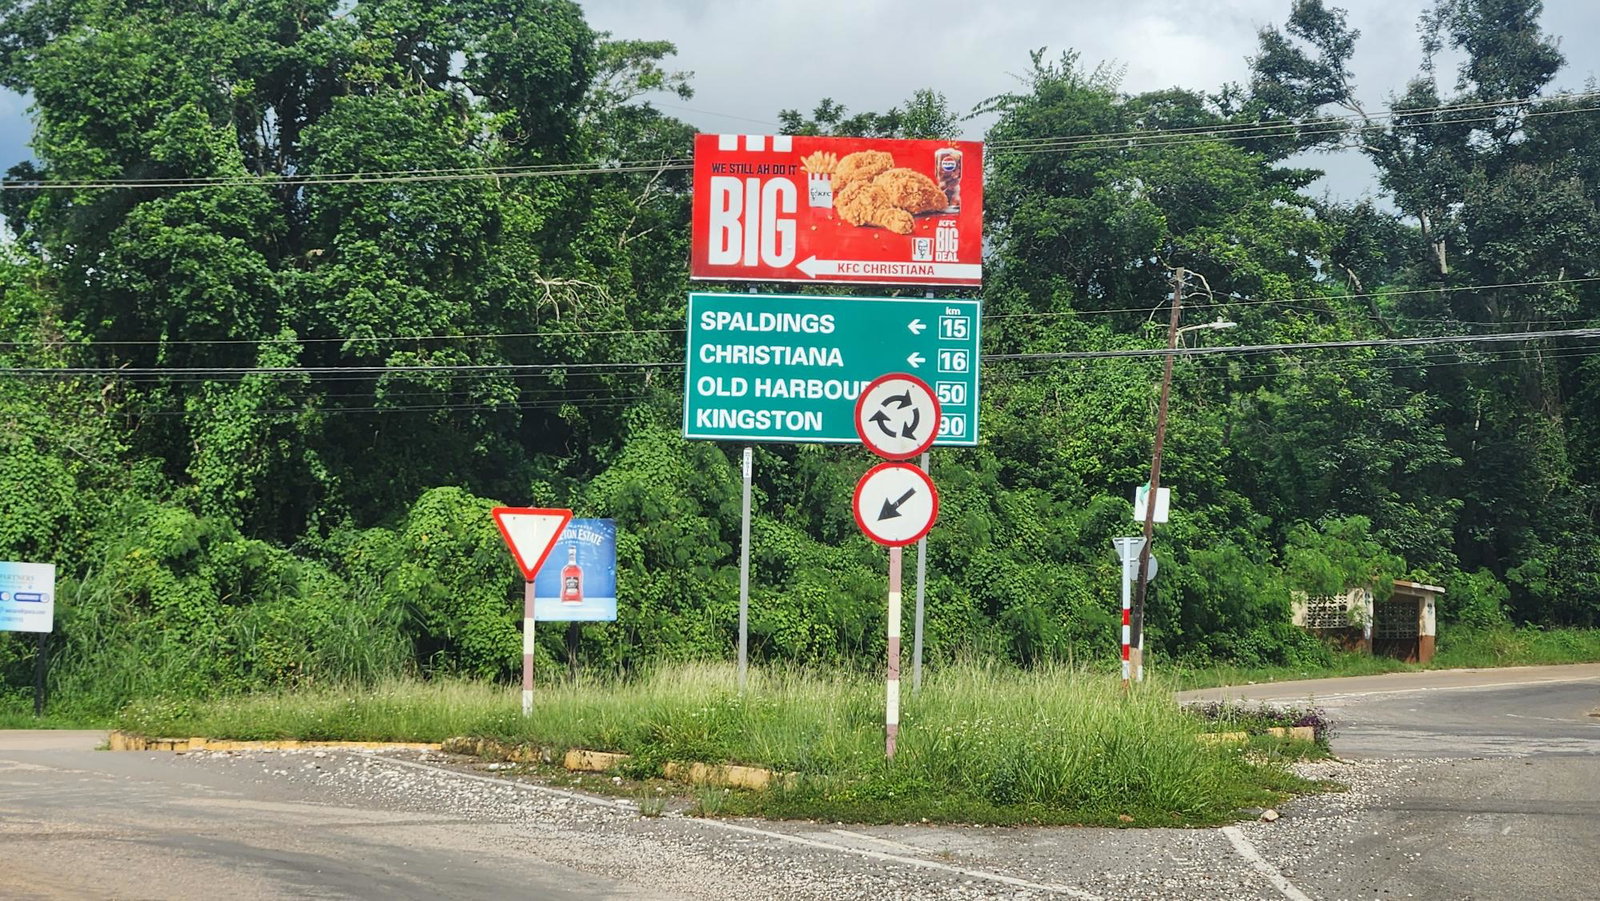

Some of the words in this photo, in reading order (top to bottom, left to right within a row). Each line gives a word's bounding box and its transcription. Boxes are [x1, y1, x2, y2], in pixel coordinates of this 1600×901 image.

[711, 163, 726, 174] WE
[729, 163, 754, 175] STILL
[757, 164, 770, 175] AH
[773, 164, 786, 175] DO
[788, 164, 798, 176] IT
[708, 175, 798, 269] BIG
[937, 219, 957, 227] KFC
[935, 226, 959, 252] BIG
[935, 250, 960, 262] DEAL
[837, 262, 861, 274] KFC
[863, 263, 935, 275] CHRISTIANA
[945, 306, 961, 316] km
[700, 310, 835, 334] SPALDINGS
[942, 319, 967, 338] 15
[699, 343, 844, 367] CHRISTIANA
[941, 351, 967, 371] 16
[697, 376, 748, 397] OLD
[938, 384, 964, 403] 50
[696, 408, 823, 431] KINGSTON
[939, 416, 964, 436] 90
[578, 528, 605, 546] ESTATE
